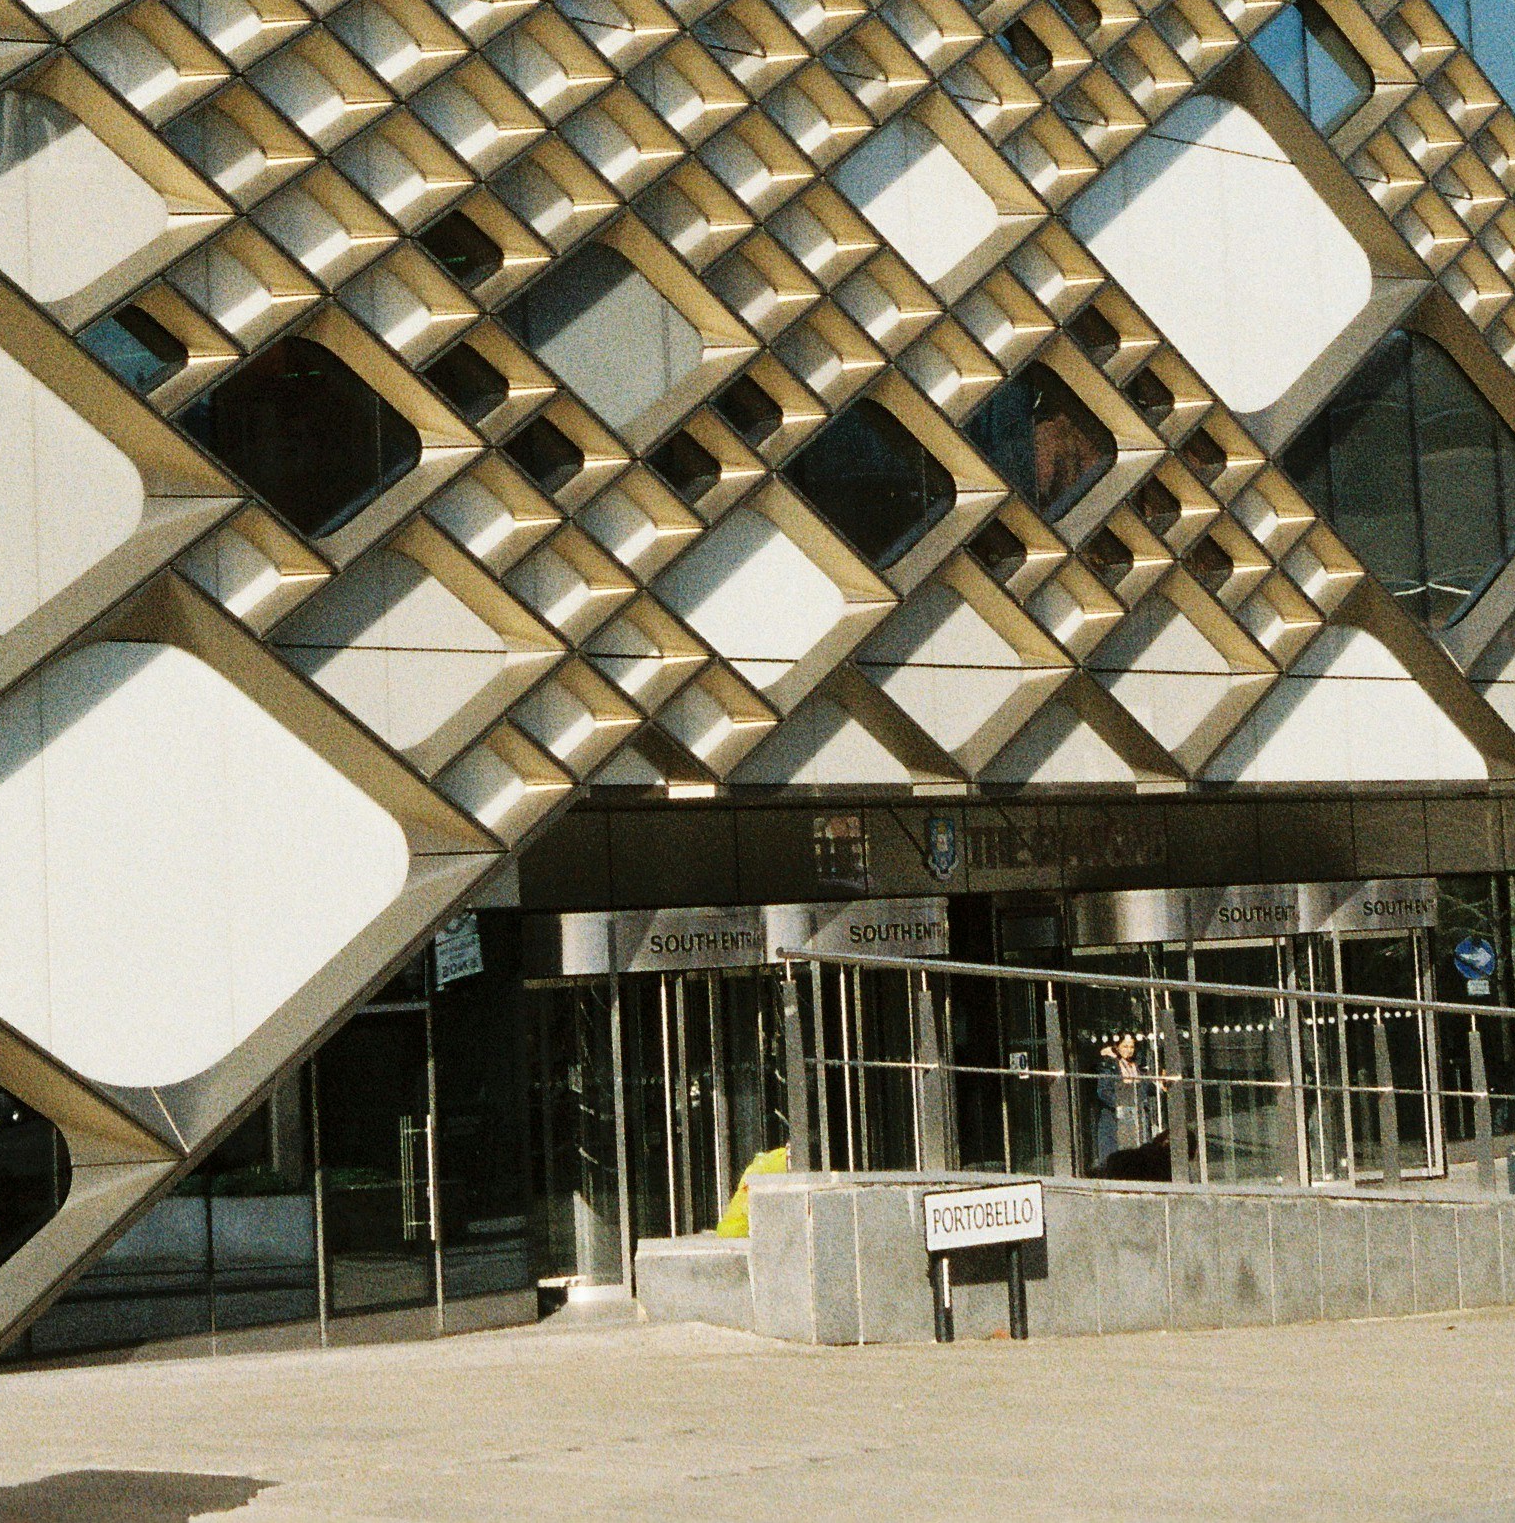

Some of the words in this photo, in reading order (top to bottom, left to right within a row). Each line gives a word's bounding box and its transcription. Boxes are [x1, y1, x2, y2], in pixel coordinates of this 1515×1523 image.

[1218, 905, 1275, 923] SOUTH
[1363, 899, 1413, 917] SOUTH
[650, 932, 717, 954] SOUTH
[849, 923, 912, 944] SOUTH
[933, 1197, 1034, 1234] PORTOBELLO
